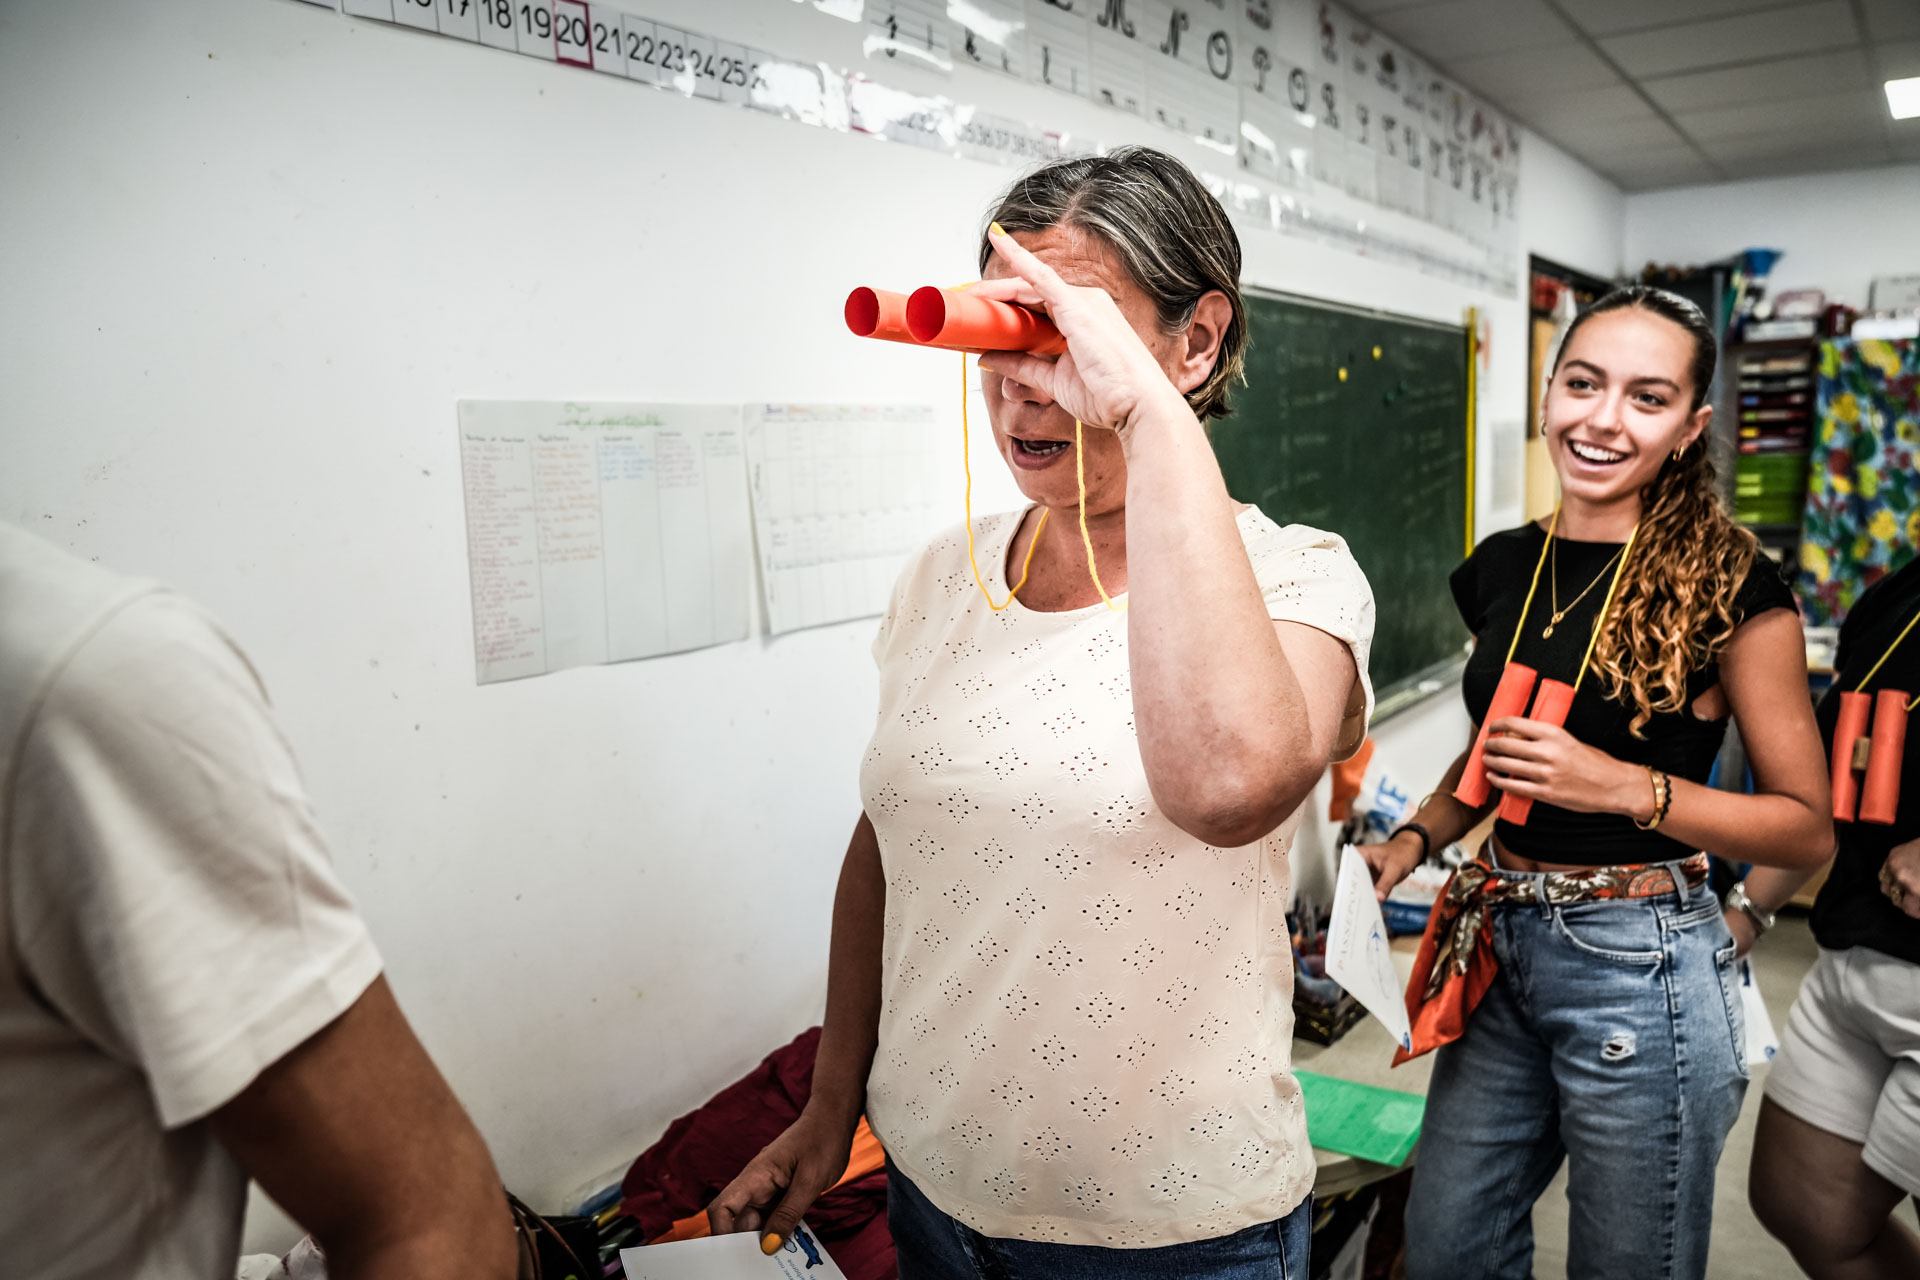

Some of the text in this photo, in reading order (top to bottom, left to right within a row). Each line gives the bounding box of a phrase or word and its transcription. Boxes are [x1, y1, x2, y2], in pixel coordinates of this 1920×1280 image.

[482, 0, 512, 29] 18
[521, 4, 550, 38] 19
[556, 14, 588, 47] 20
[593, 23, 622, 56] 21
[627, 32, 655, 65] 22
[659, 41, 686, 73] 23
[690, 49, 715, 78] 24
[720, 57, 747, 87] 25
